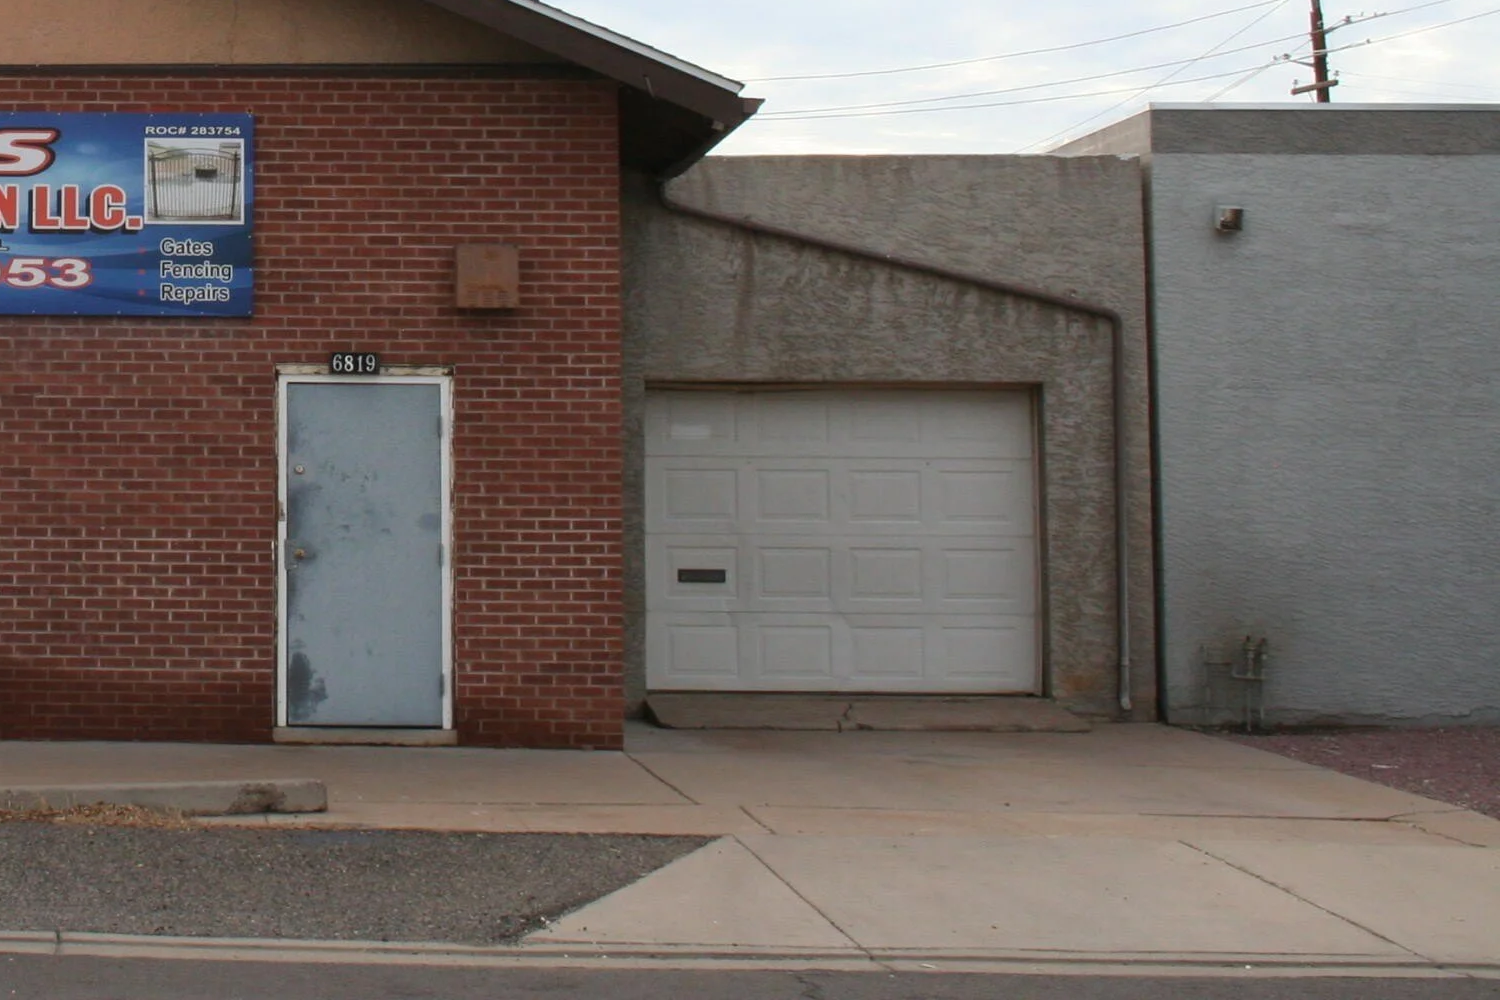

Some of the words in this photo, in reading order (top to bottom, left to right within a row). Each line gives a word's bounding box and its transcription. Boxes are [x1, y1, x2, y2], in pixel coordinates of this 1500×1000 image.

[145, 126, 187, 135] ROC#
[191, 126, 241, 136] 283754
[31, 184, 144, 231] LLC.
[160, 238, 213, 256] Gates
[160, 260, 232, 281] Fencing
[160, 283, 229, 303] Repairs
[332, 353, 376, 372] 6819
